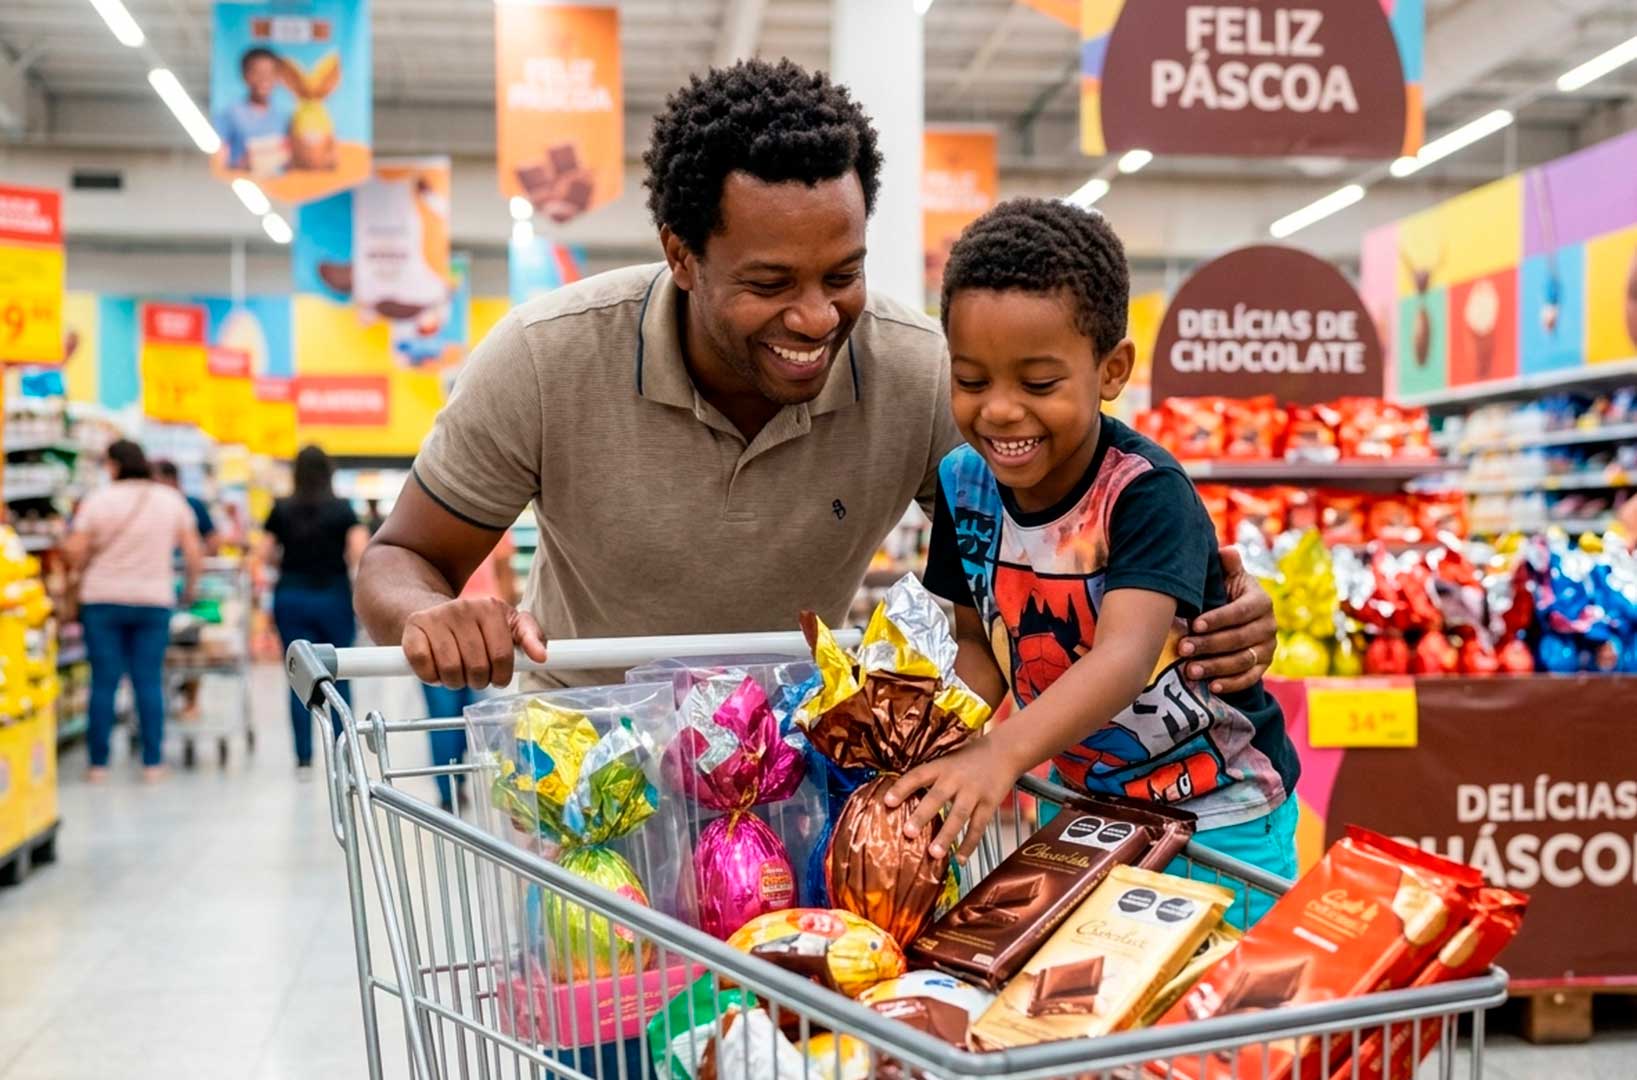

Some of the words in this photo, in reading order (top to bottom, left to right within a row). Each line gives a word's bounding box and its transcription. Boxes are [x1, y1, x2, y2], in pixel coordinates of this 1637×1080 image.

[1186, 6, 1324, 57] FELIZ
[1151, 48, 1359, 113] PÁSCOA
[1178, 302, 1313, 341] DELÍCIAS
[1316, 310, 1359, 341] DE
[1170, 340, 1367, 373] CHOCOLATE
[1456, 773, 1637, 823] DELÍCIAS
